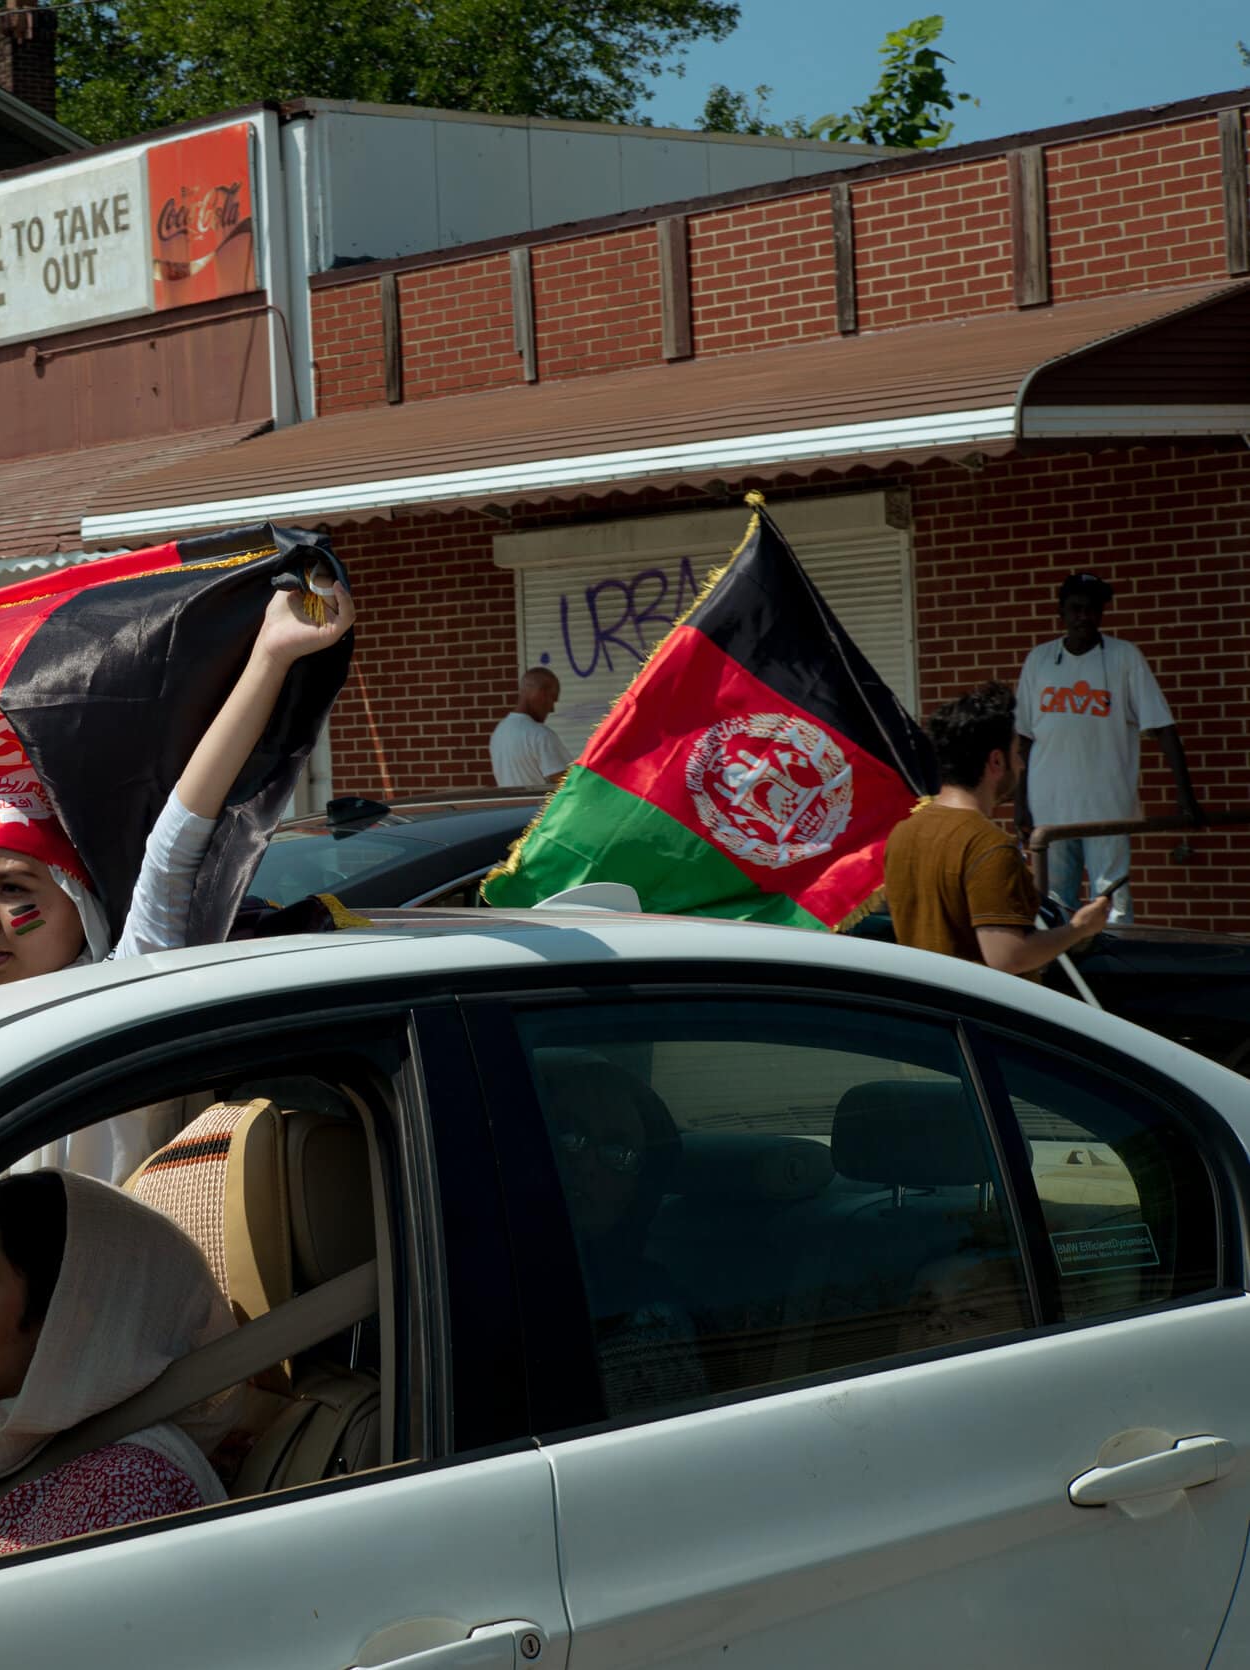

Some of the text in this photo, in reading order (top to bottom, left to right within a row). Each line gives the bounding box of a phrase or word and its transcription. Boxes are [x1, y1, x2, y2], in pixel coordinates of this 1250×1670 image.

[12, 193, 130, 257] TO TAKE
[42, 248, 98, 295] OUT
[1039, 685, 1112, 718] CAVS
